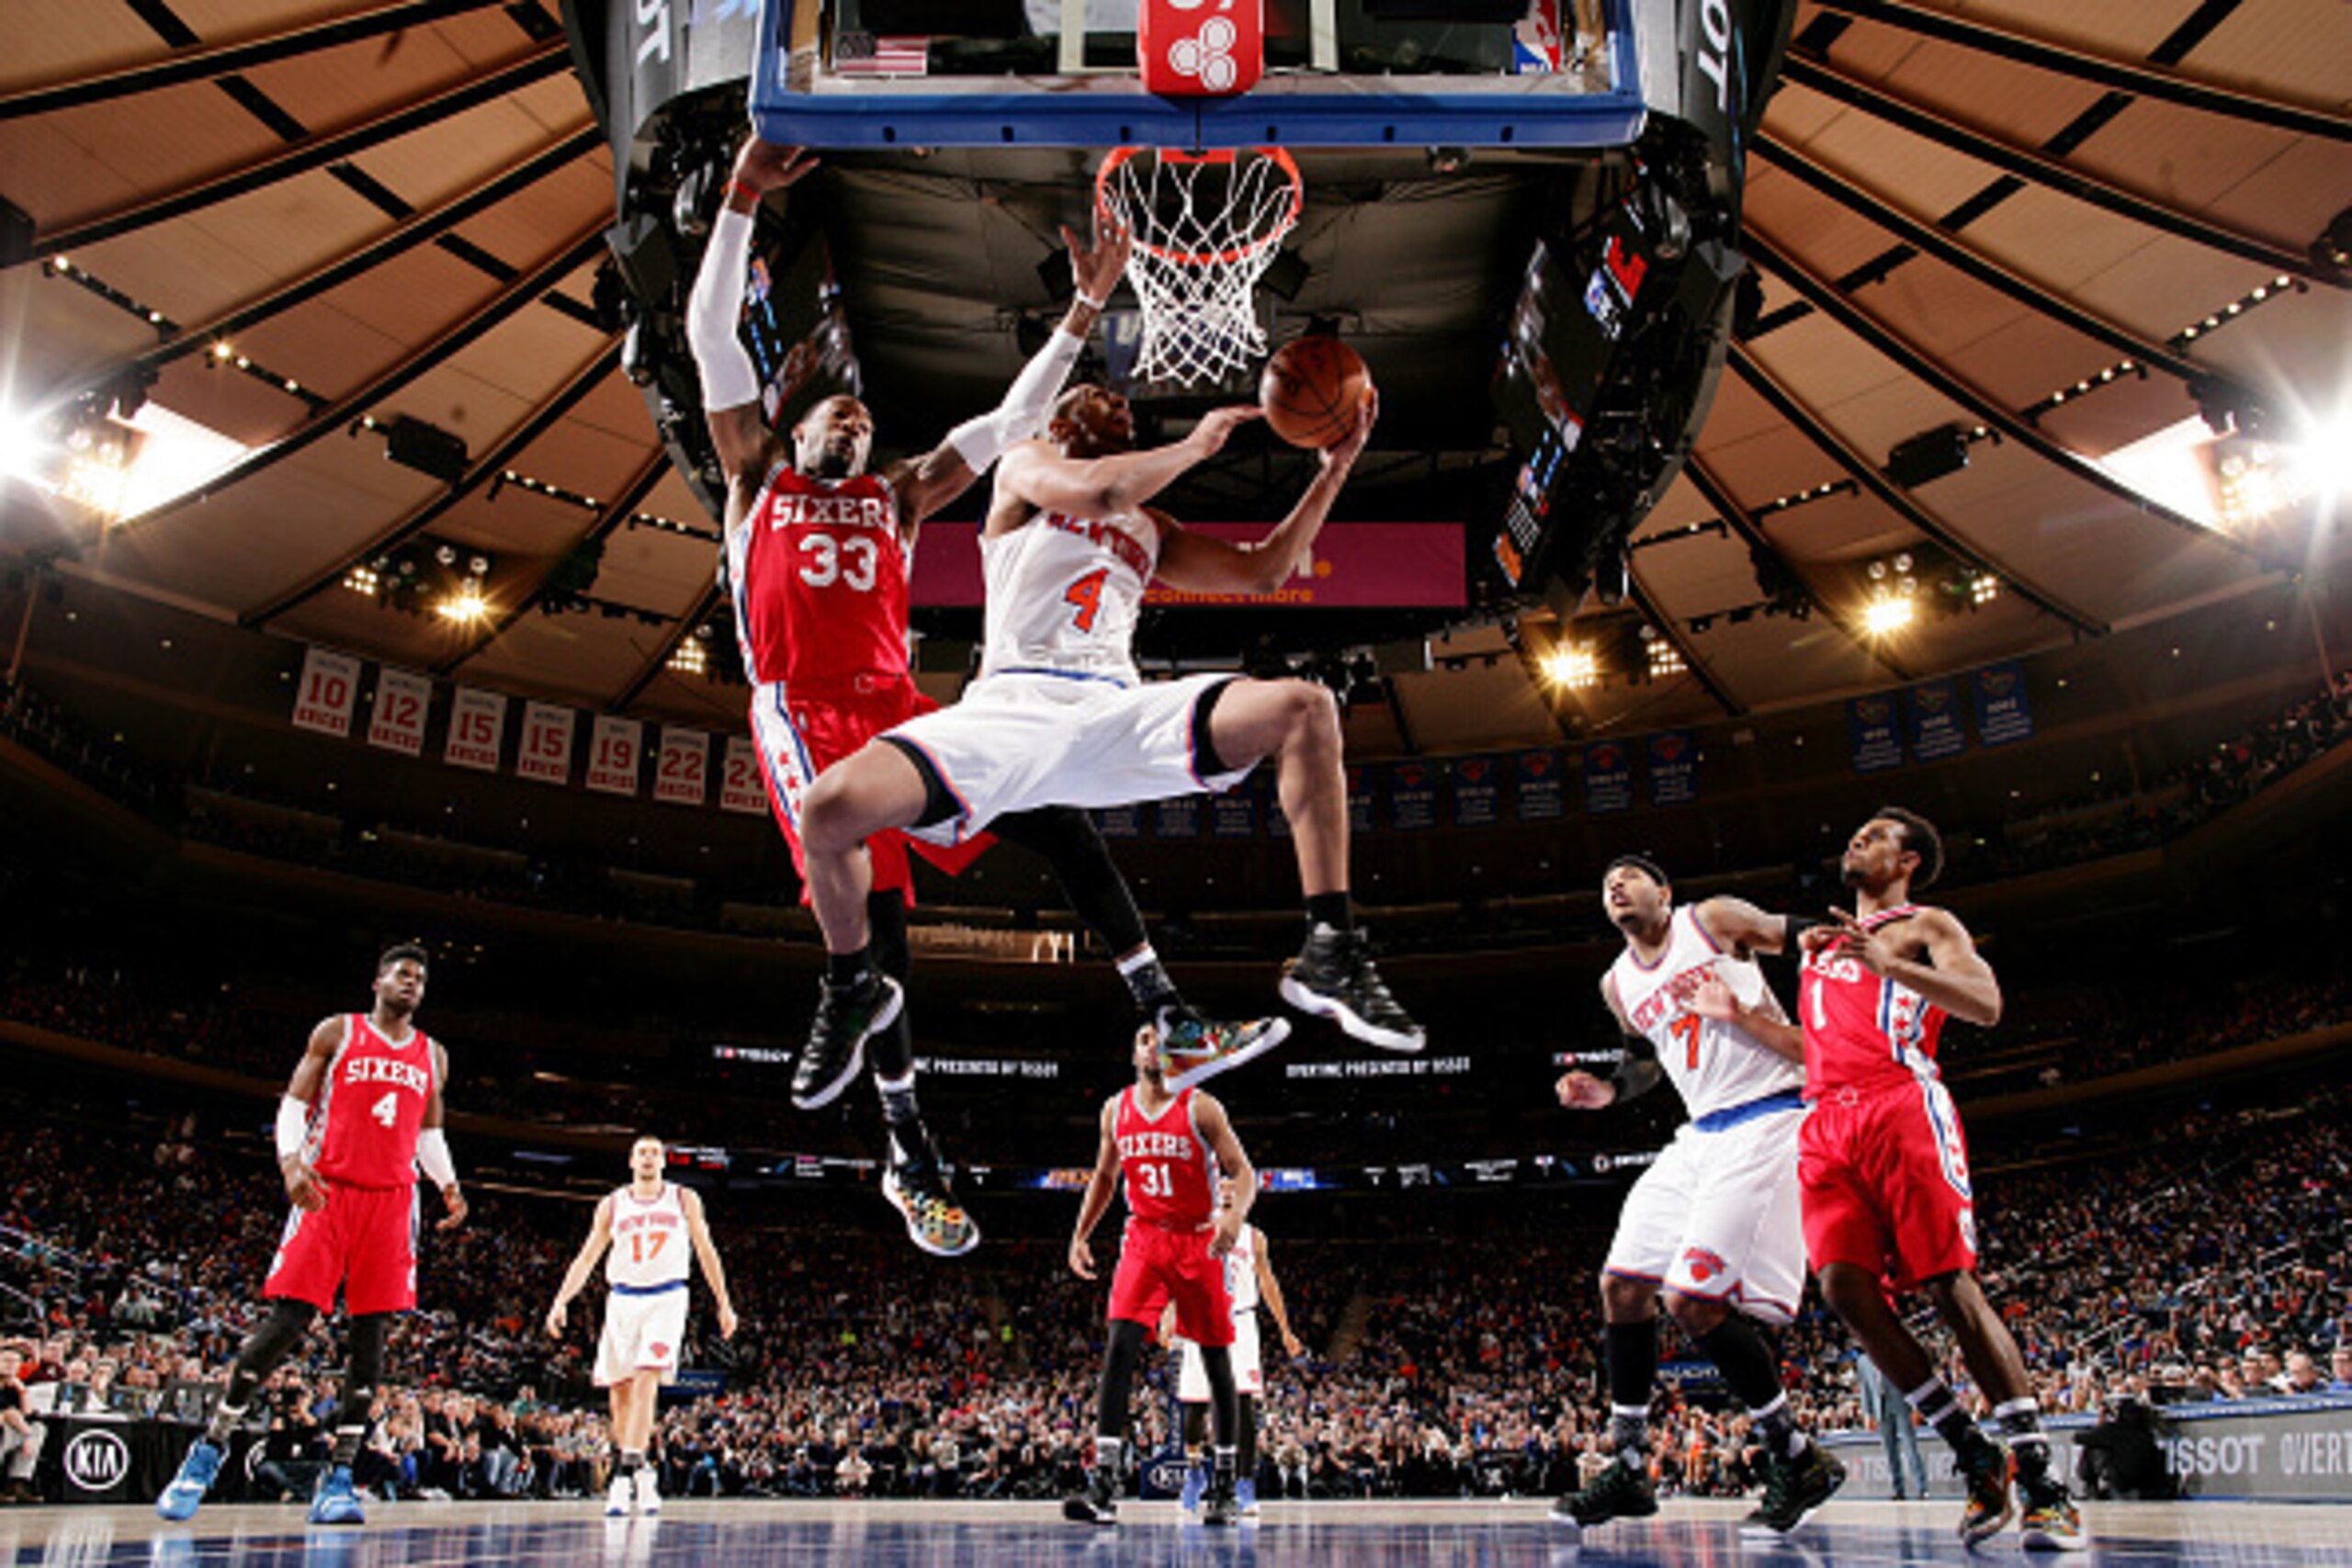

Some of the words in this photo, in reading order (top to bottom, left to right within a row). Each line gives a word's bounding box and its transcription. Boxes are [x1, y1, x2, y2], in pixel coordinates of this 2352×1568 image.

[799, 533, 876, 591] 33
[1063, 567, 1110, 634] 4
[308, 672, 348, 710] 10
[380, 693, 421, 728] 12
[458, 711, 496, 746] 15
[527, 724, 565, 759] 15
[597, 739, 632, 770] 19
[661, 749, 703, 781] 22
[1809, 979, 1826, 1030] 1
[1671, 1012, 1701, 1070] 7
[345, 1056, 428, 1097] SIXERS
[371, 1091, 398, 1129] 4
[1138, 1162, 1173, 1197] 31
[631, 1231, 668, 1263] 17
[74, 1441, 117, 1477] KIA
